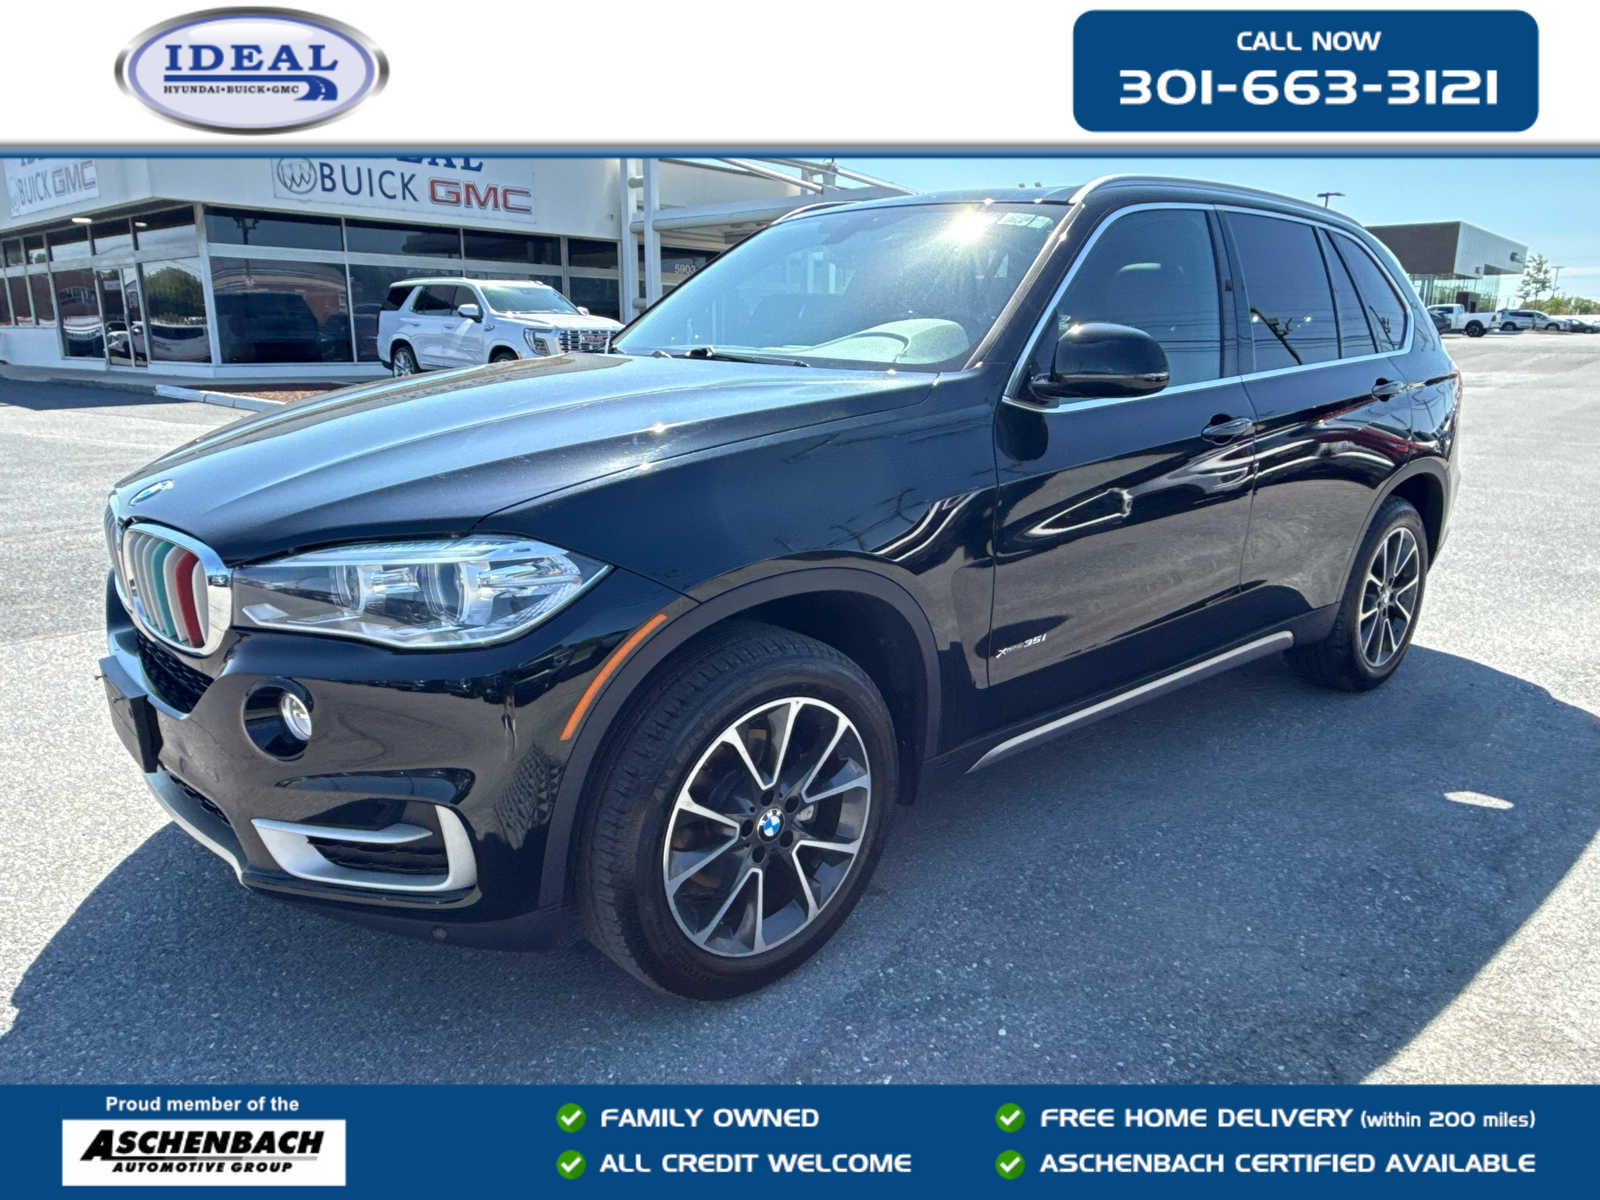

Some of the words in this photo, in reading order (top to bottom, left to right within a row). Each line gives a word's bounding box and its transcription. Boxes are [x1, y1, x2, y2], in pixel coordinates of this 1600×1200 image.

[15, 169, 52, 207] BUICK
[52, 159, 97, 197] GMC
[319, 162, 419, 202] BUICK
[428, 177, 533, 215] GMC
